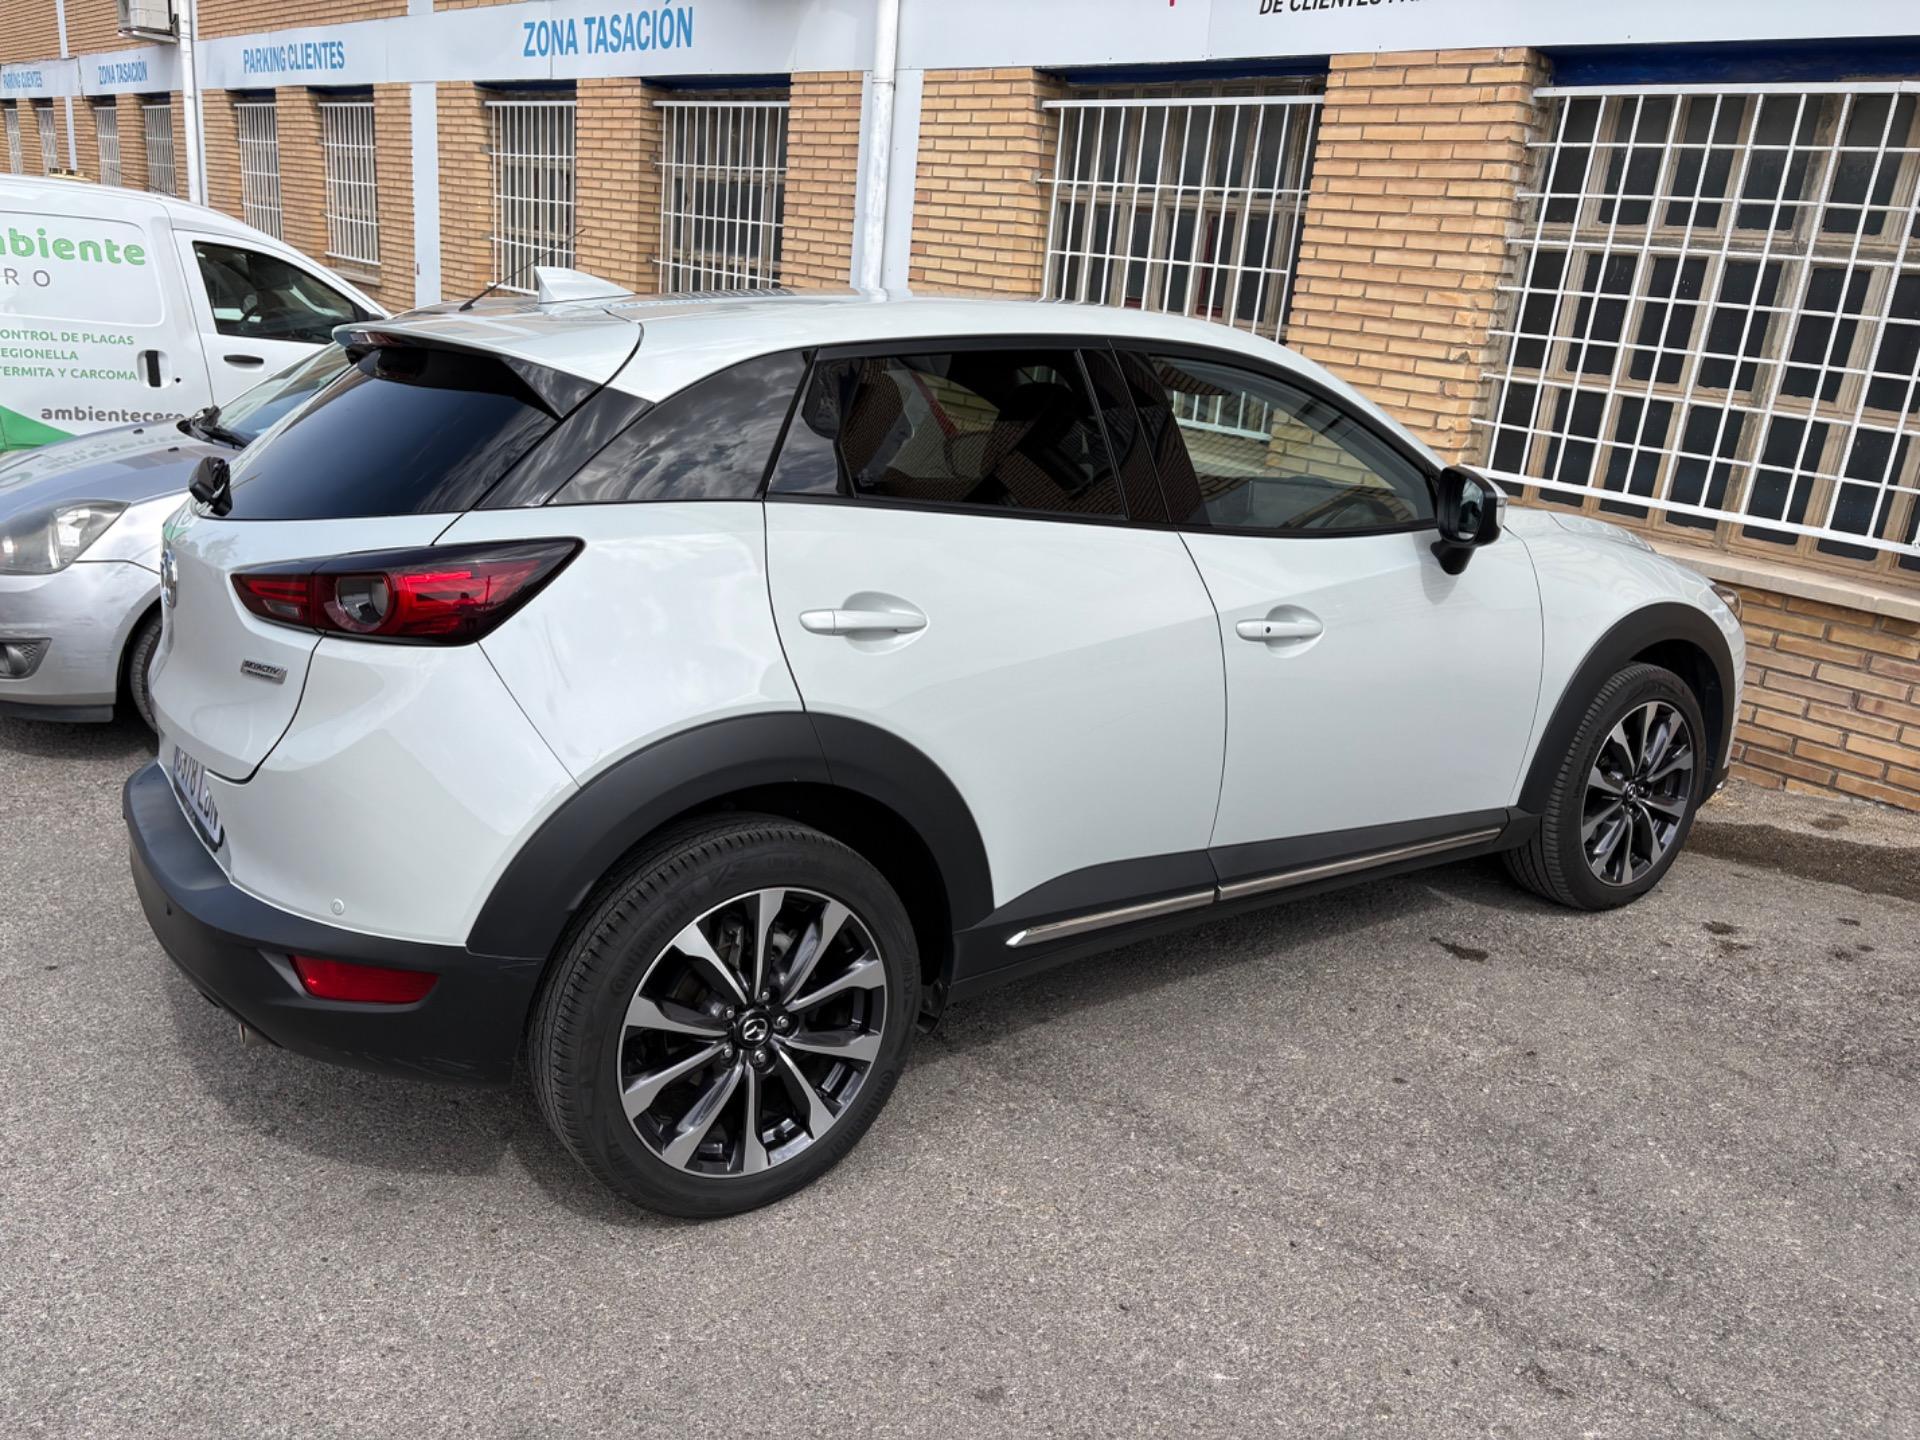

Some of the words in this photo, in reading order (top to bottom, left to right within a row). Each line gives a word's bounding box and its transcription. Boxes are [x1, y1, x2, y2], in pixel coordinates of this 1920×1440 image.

[523, 18, 578, 57] ZONA
[584, 0, 693, 54] TASACIÓN
[243, 46, 286, 74] PARKING
[288, 40, 345, 70] CLIENTES
[0, 228, 146, 266] biente
[61, 332, 78, 343] DE
[82, 333, 134, 345] PLAGAS
[0, 366, 54, 378] ERMITA
[58, 368, 67, 377] Y
[70, 368, 137, 381] CARCOMA
